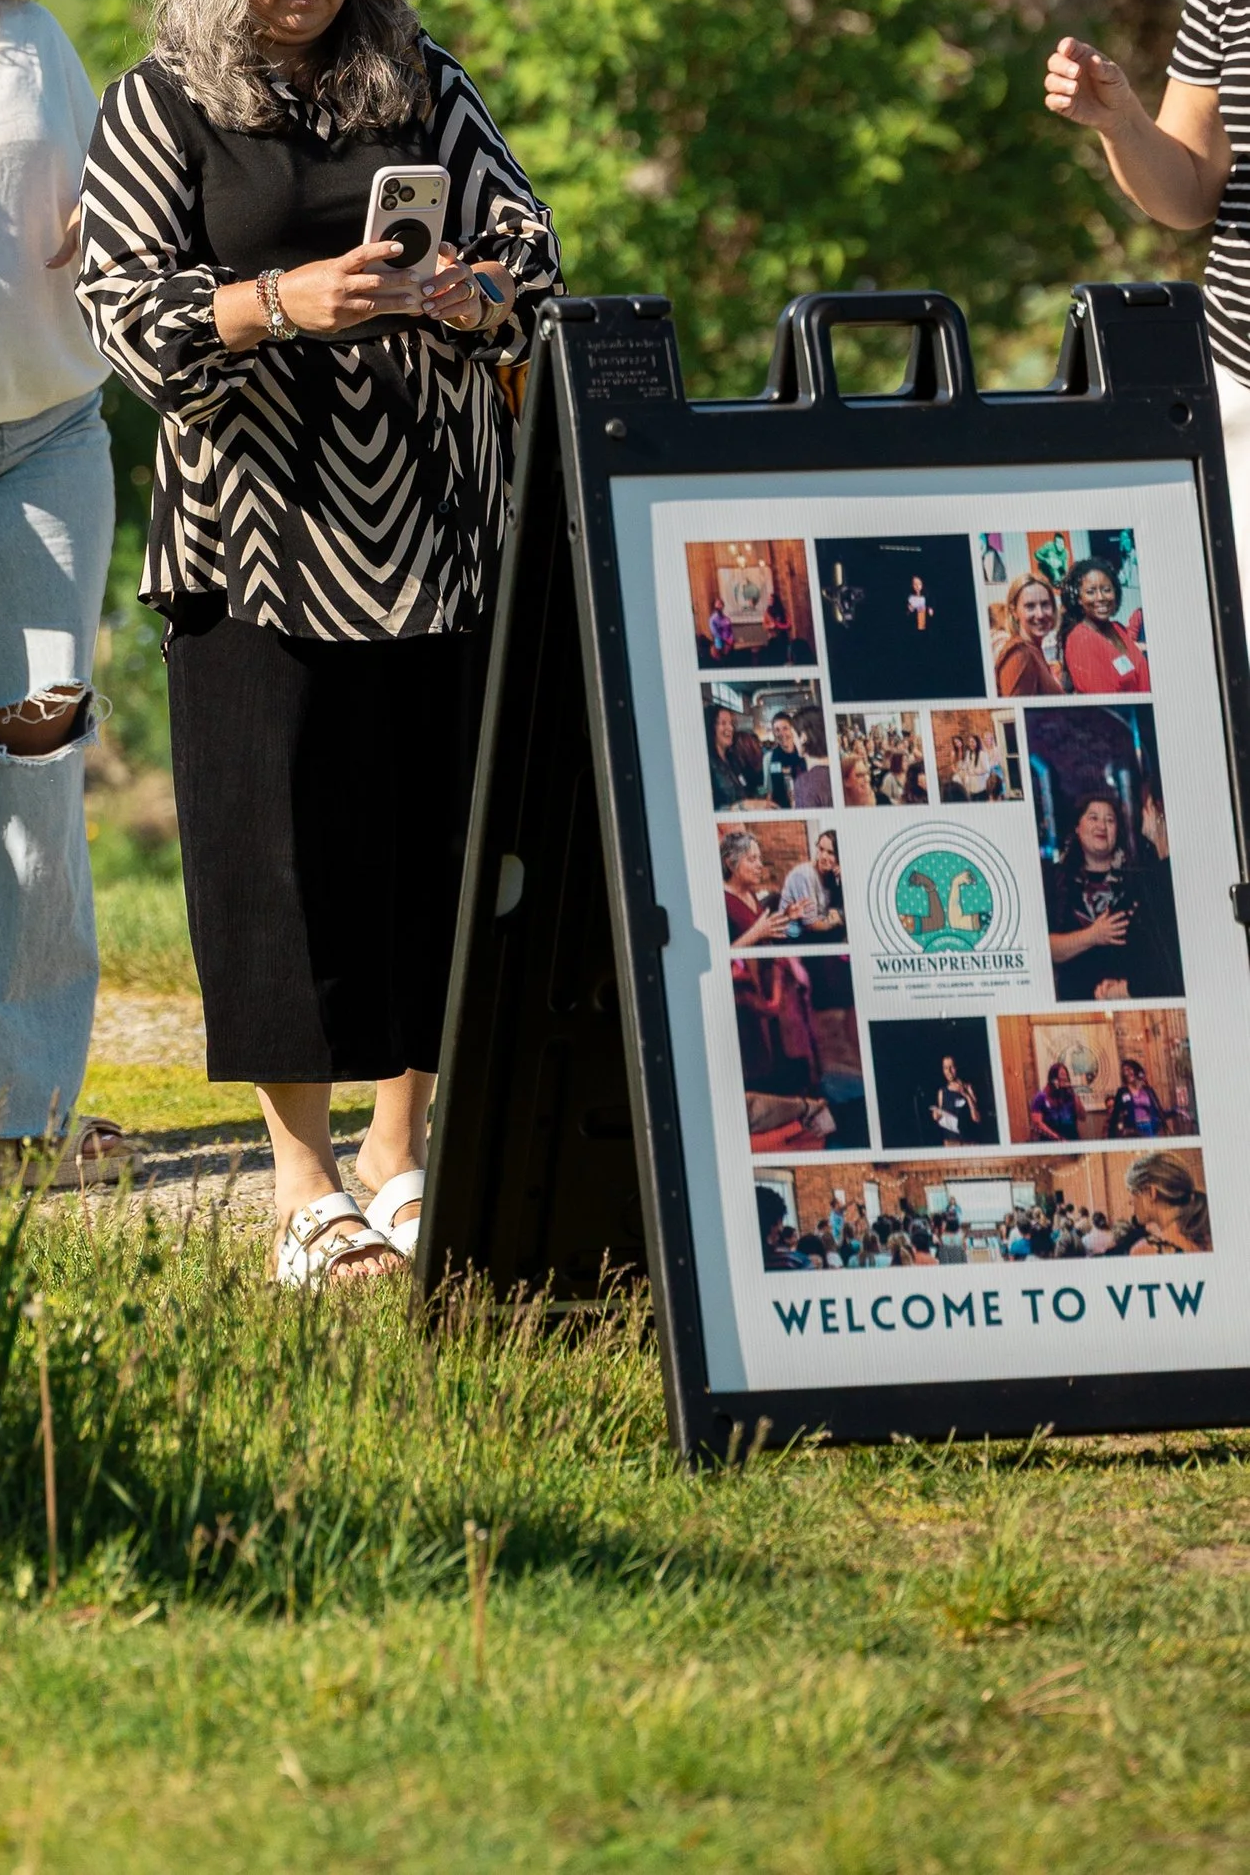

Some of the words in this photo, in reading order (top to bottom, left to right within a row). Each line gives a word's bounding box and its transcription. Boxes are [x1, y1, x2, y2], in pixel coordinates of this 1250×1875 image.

[876, 953, 1025, 974] WOMENPRENEURS
[772, 1290, 1003, 1336] WELCOME
[1021, 1286, 1087, 1324] TO
[1105, 1280, 1206, 1320] VTW
